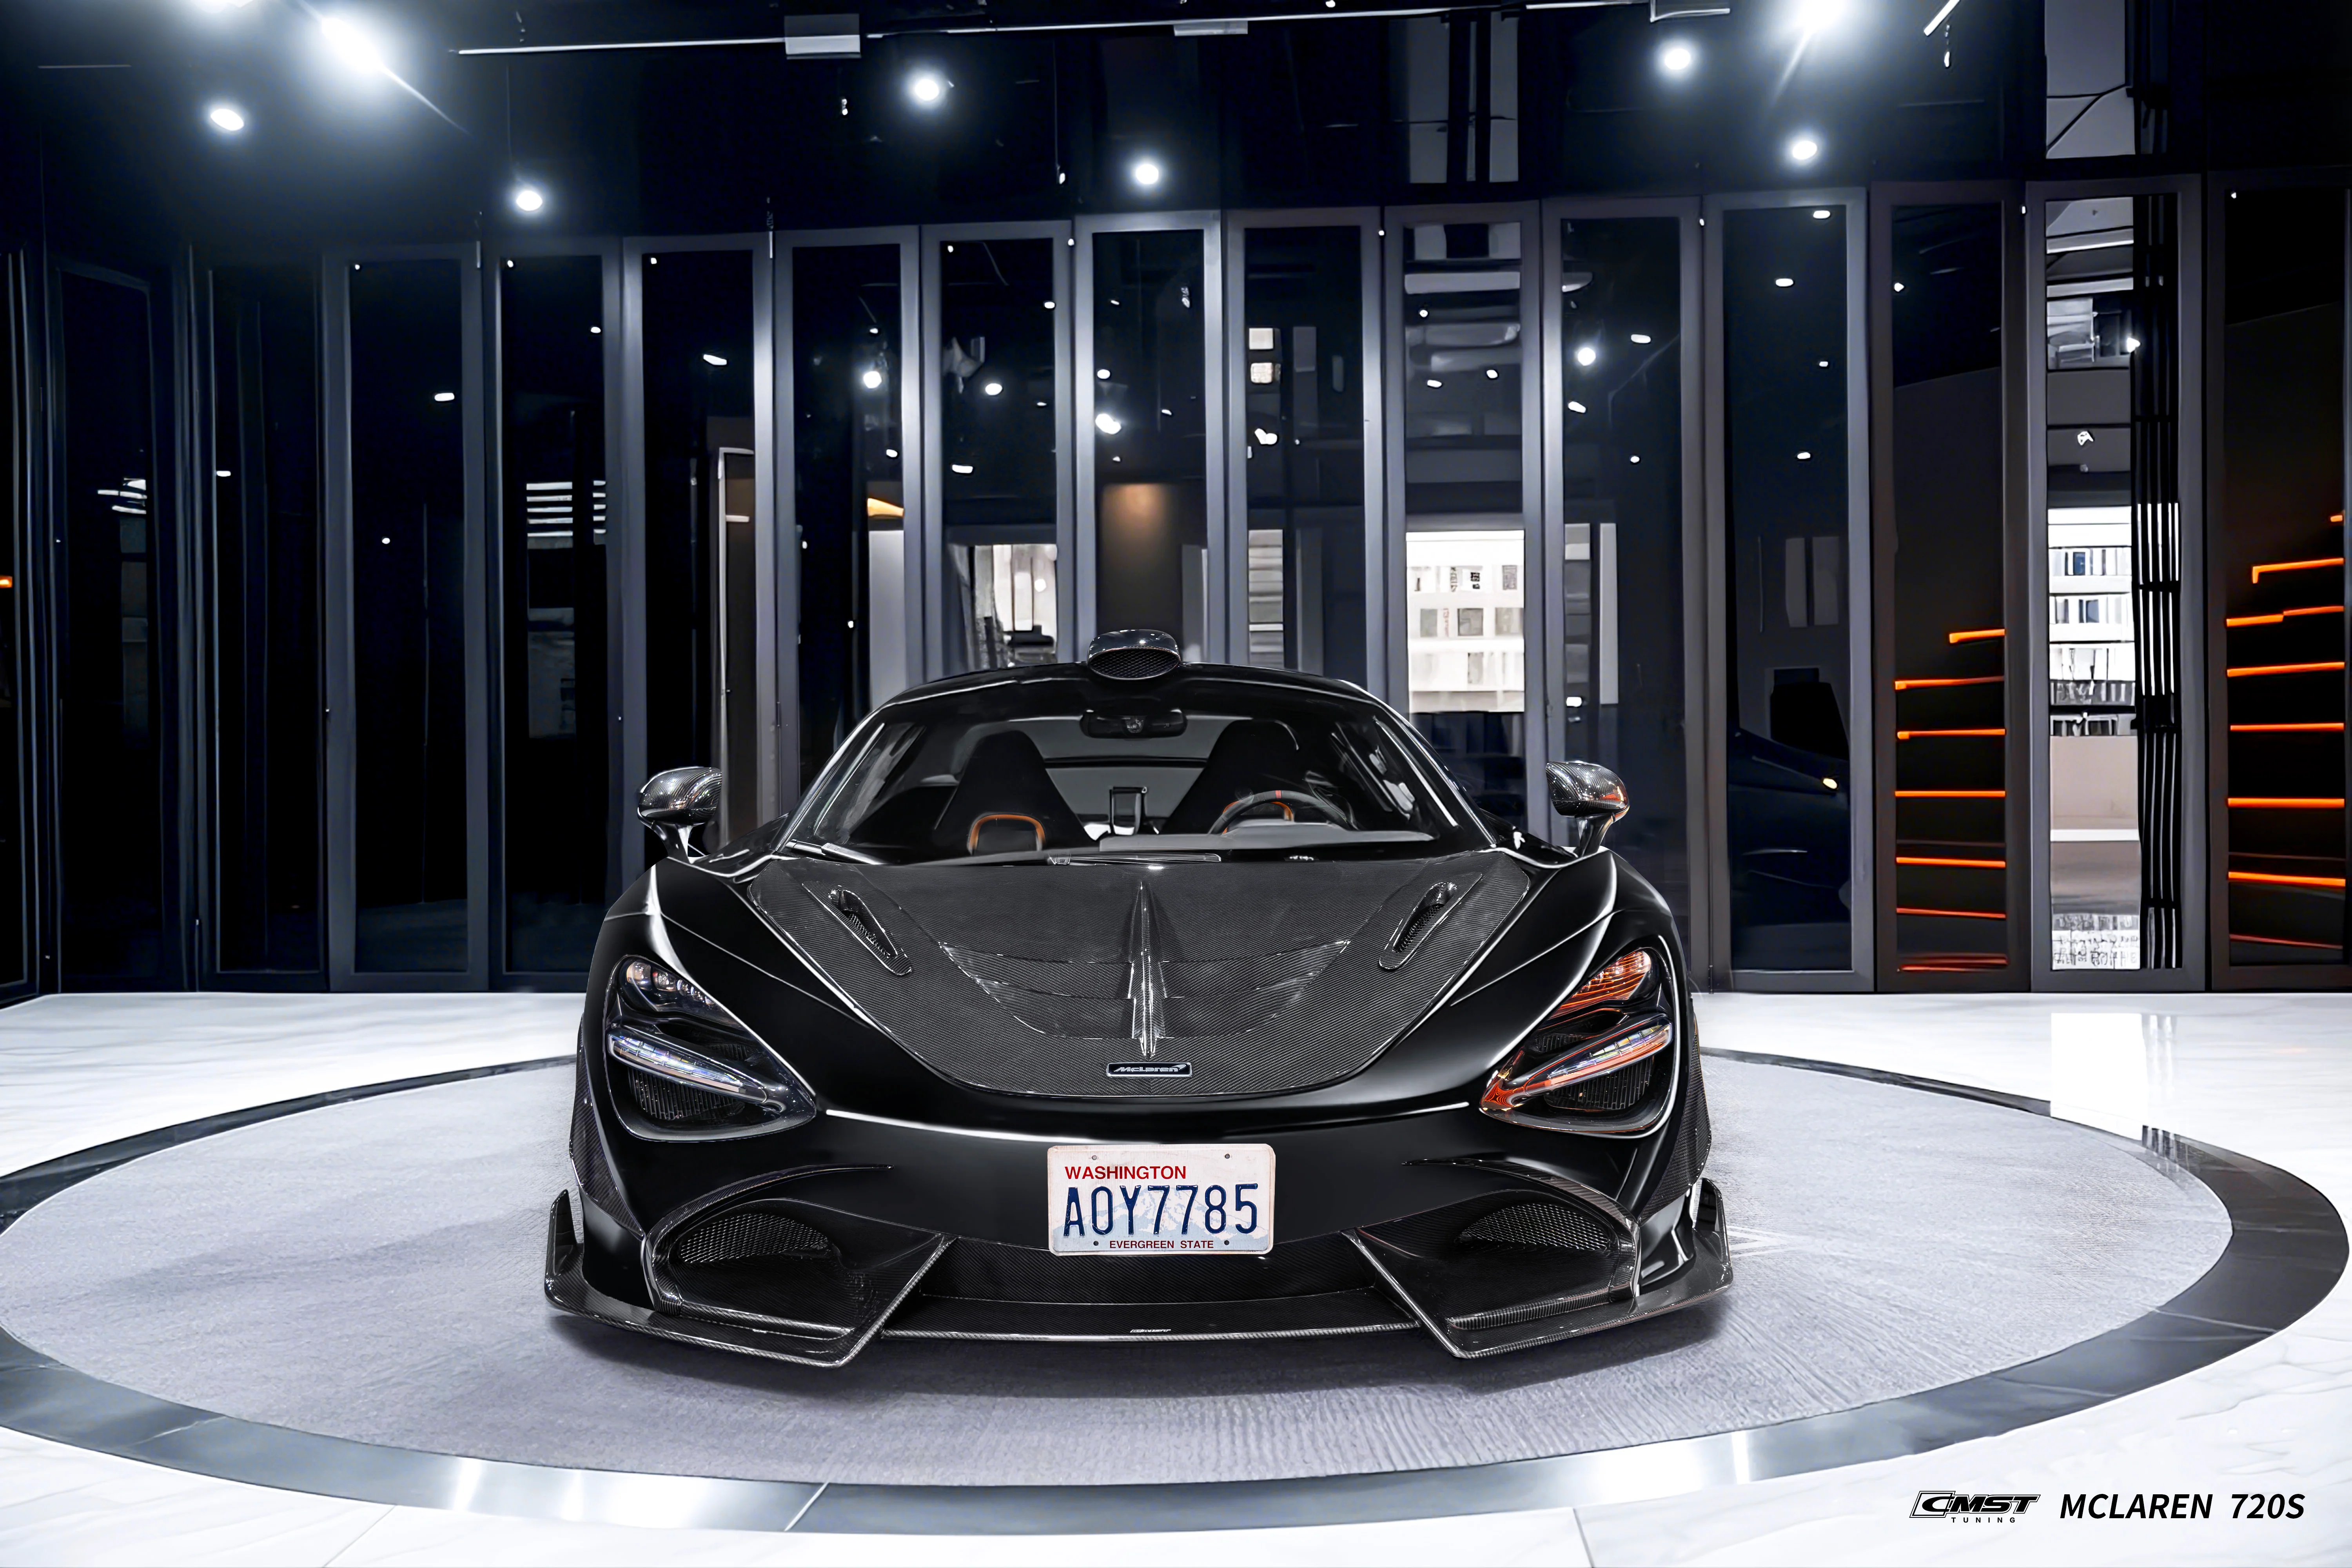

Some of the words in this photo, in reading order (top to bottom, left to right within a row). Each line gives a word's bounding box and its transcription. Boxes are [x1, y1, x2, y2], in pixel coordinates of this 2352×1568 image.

[1065, 1165, 1186, 1180] WASHINGTON
[1110, 1240, 1174, 1249] EVERGREEN
[1180, 1240, 1214, 1249] STATE
